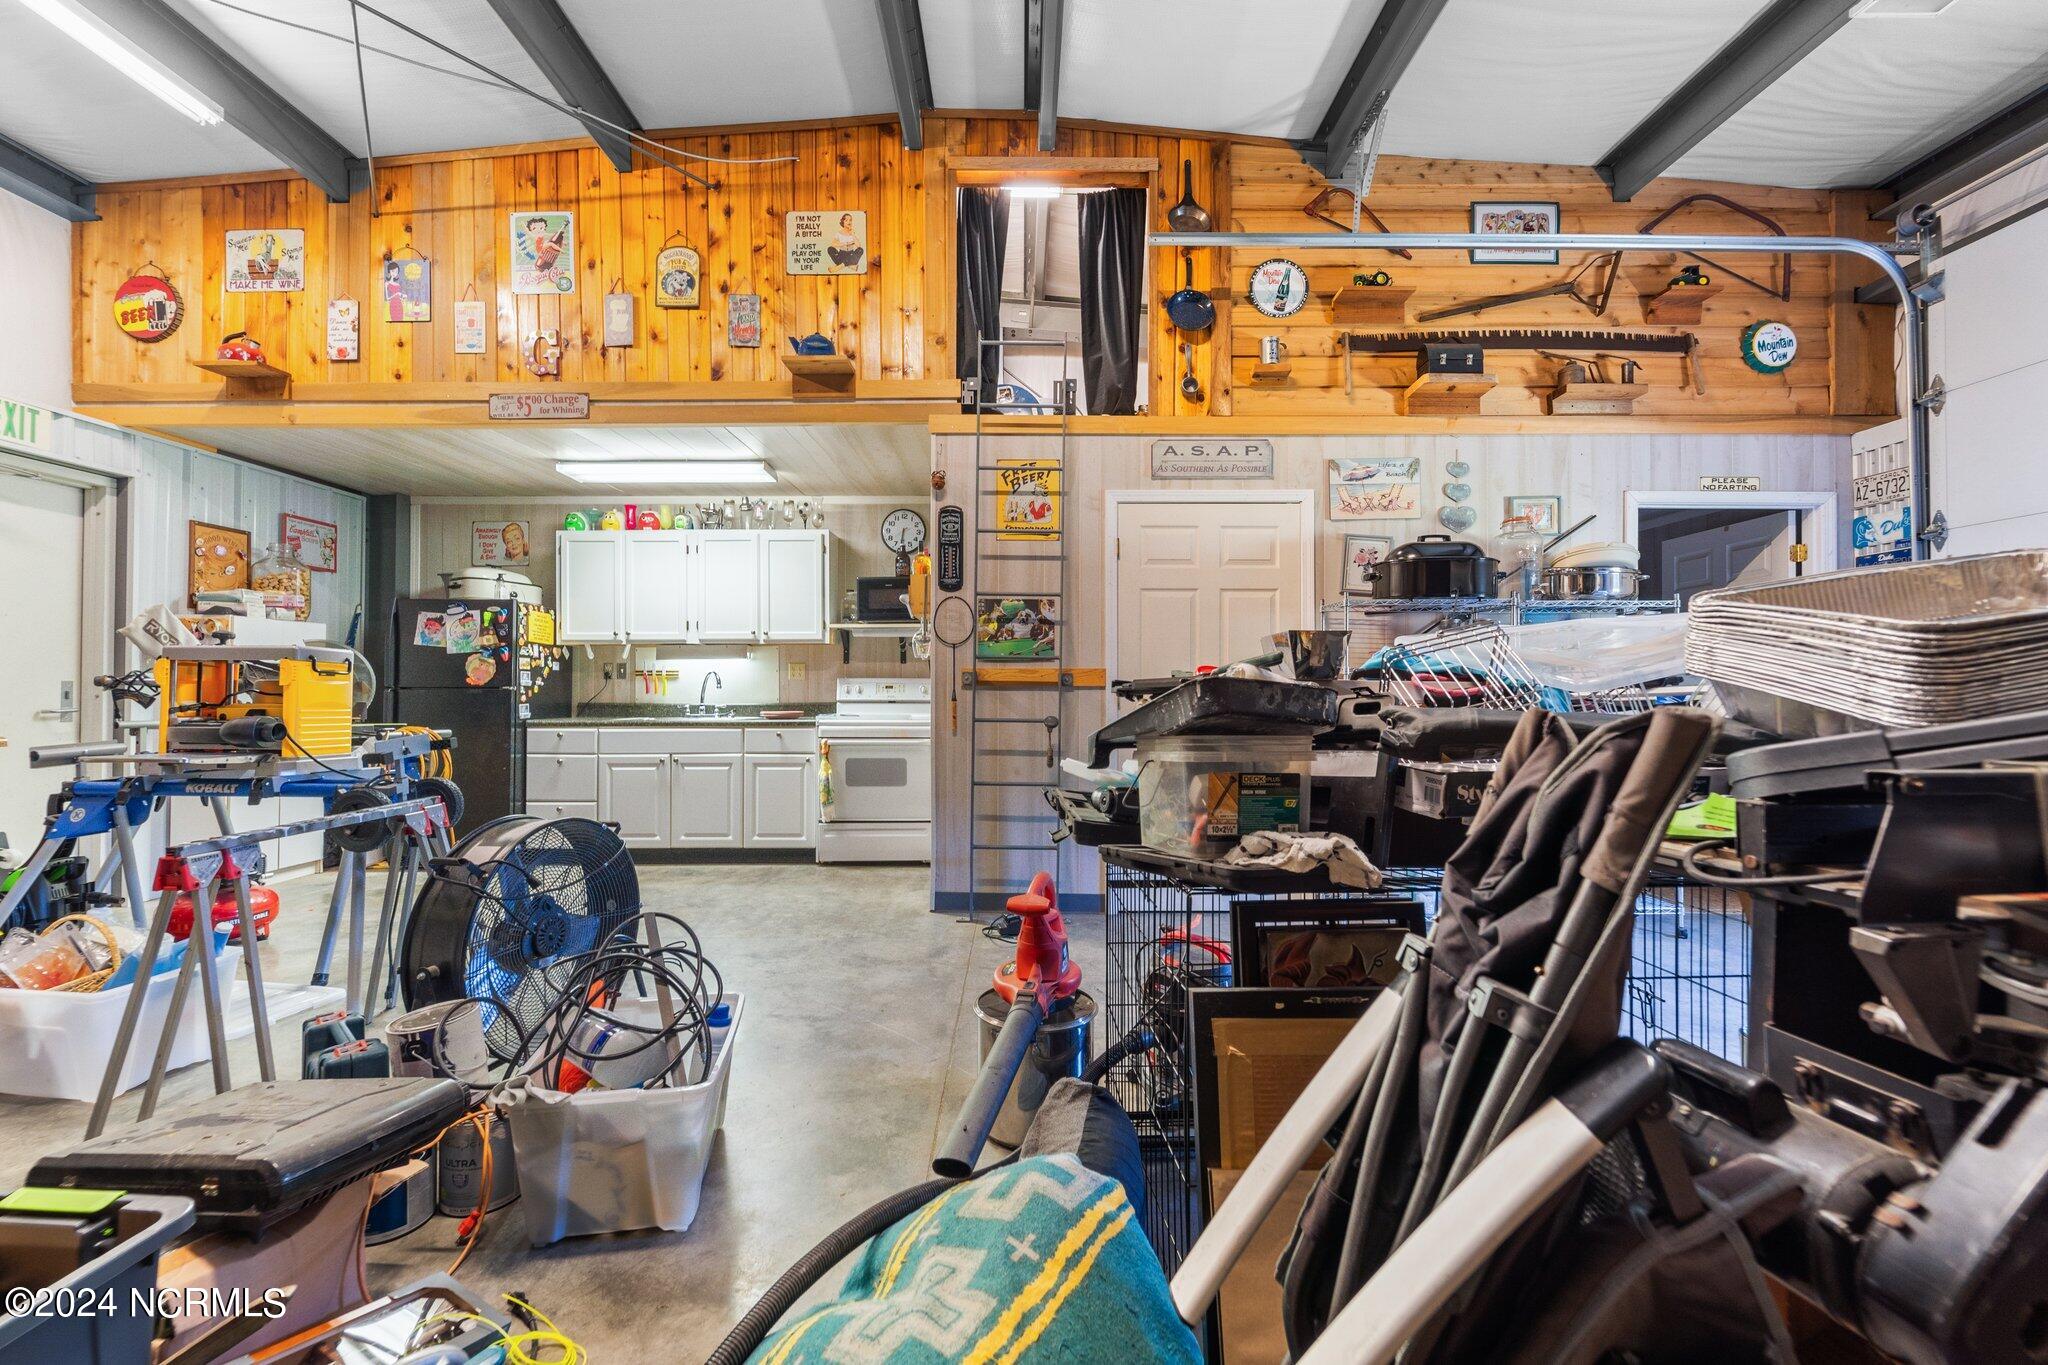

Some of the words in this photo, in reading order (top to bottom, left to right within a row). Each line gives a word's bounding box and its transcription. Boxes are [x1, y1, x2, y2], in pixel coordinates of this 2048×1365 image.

[229, 281, 257, 289] MAKE
[261, 281, 273, 289] ME
[278, 280, 301, 289] WINE
[121, 306, 155, 326] BEER
[1757, 337, 1794, 353] Mountain
[1769, 351, 1788, 362] Dew
[544, 395, 580, 406] Charge
[0, 400, 40, 443] XIT
[1001, 462, 1036, 486] FREE
[1010, 470, 1051, 494] BEER!
[1856, 476, 1905, 501] AZ-6732
[185, 783, 239, 794] KOBALT
[253, 911, 268, 920] CABLE
[445, 1159, 477, 1168] ULTRA
